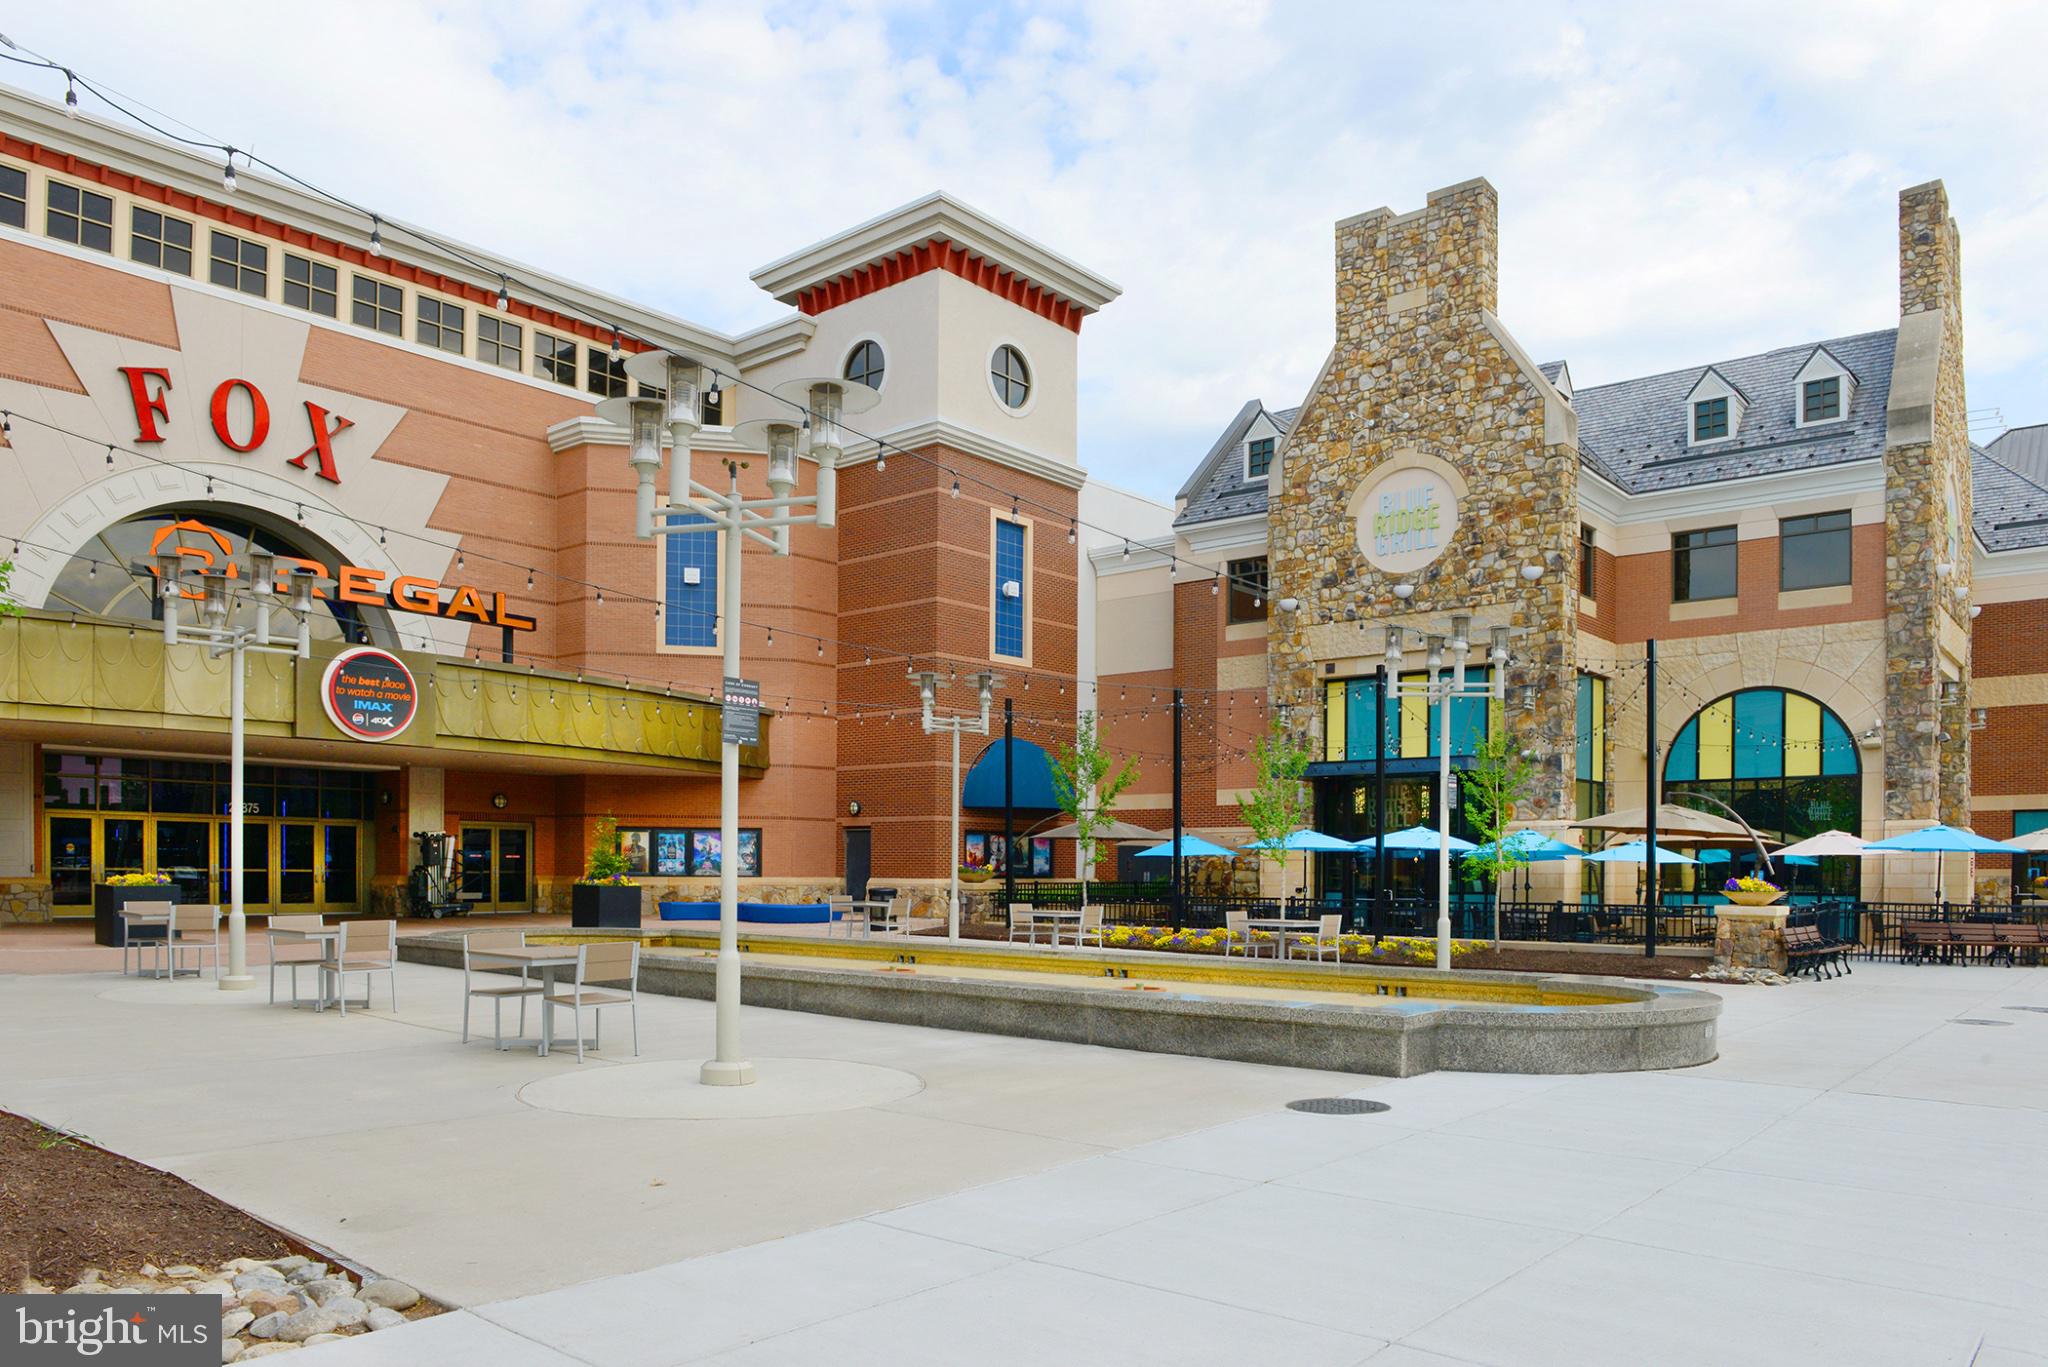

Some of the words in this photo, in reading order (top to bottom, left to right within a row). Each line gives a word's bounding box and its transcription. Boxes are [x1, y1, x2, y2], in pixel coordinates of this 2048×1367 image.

[117, 366, 355, 484] FOX
[1379, 484, 1434, 517] BLUE
[1374, 503, 1440, 538] RIDGE
[1376, 527, 1438, 556] GRILL
[273, 555, 535, 632] REGAL
[335, 686, 346, 695] to
[348, 687, 375, 697] watch
[384, 692, 411, 701] movie
[342, 675, 357, 684] the
[359, 676, 380, 687] best
[382, 680, 406, 690] place
[354, 700, 393, 712] IMAX
